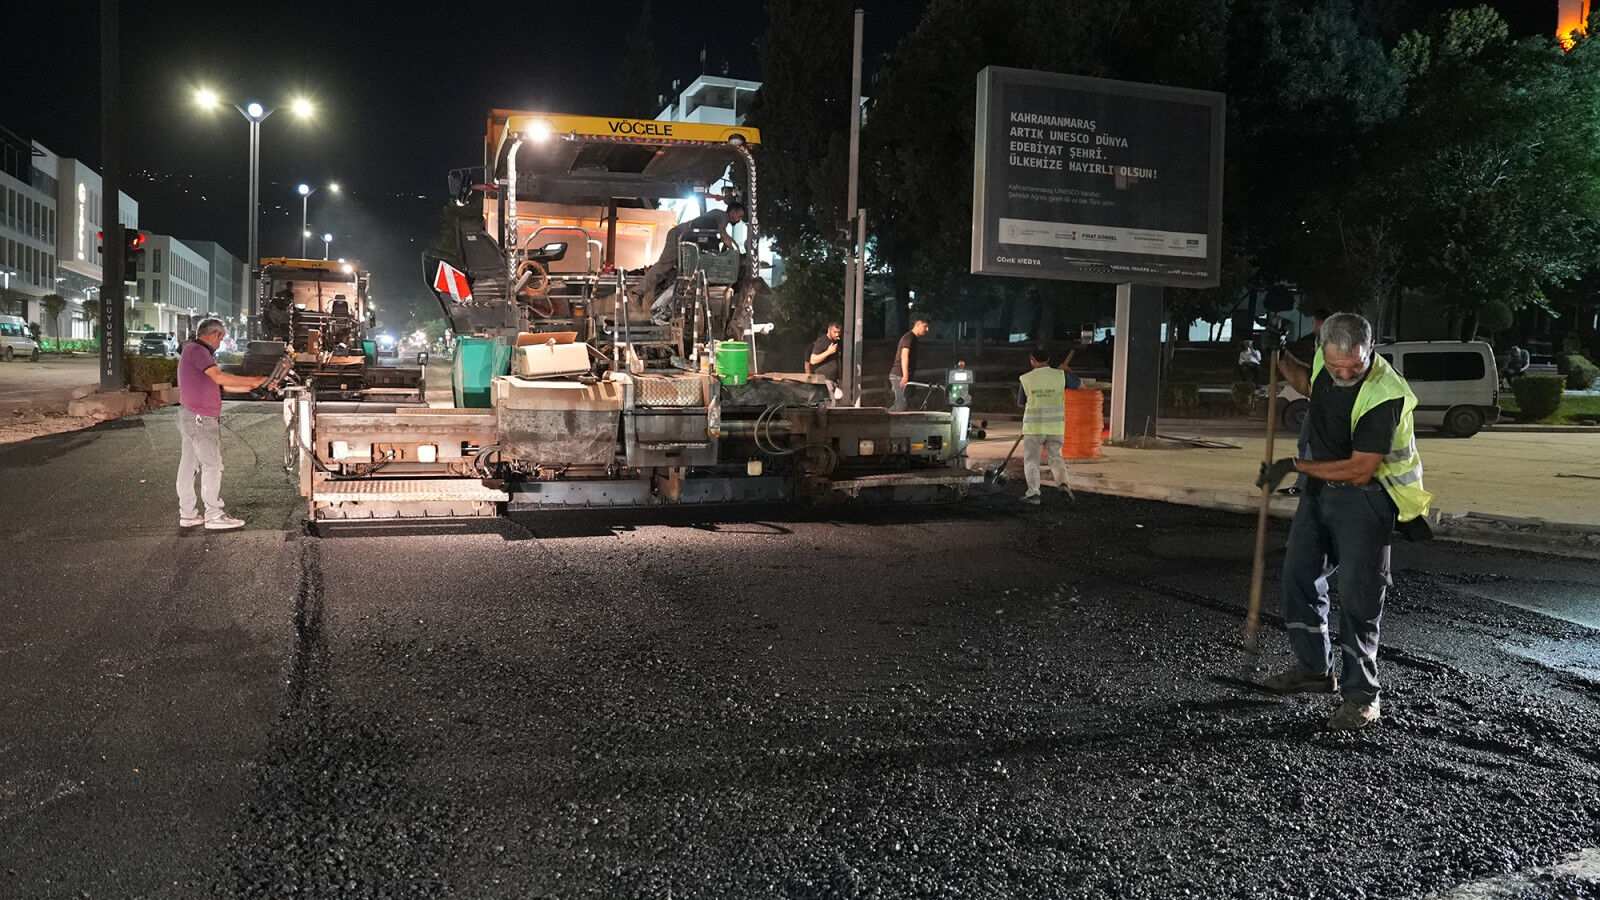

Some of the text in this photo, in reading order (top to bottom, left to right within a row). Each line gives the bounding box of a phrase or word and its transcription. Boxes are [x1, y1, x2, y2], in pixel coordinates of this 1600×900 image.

[608, 119, 673, 136] VÖGELE
[1010, 112, 1096, 132] KAHRAMANMARAŞ
[1010, 127, 1128, 148] ARTIK UNESCO DÜNYA
[1010, 141, 1107, 160] EDEBİYAT ŞEHRİ.
[1009, 153, 1158, 179] ÜLKEMİZE HAYIRLI OLSUN!
[1018, 258, 1041, 266] MEDYA
